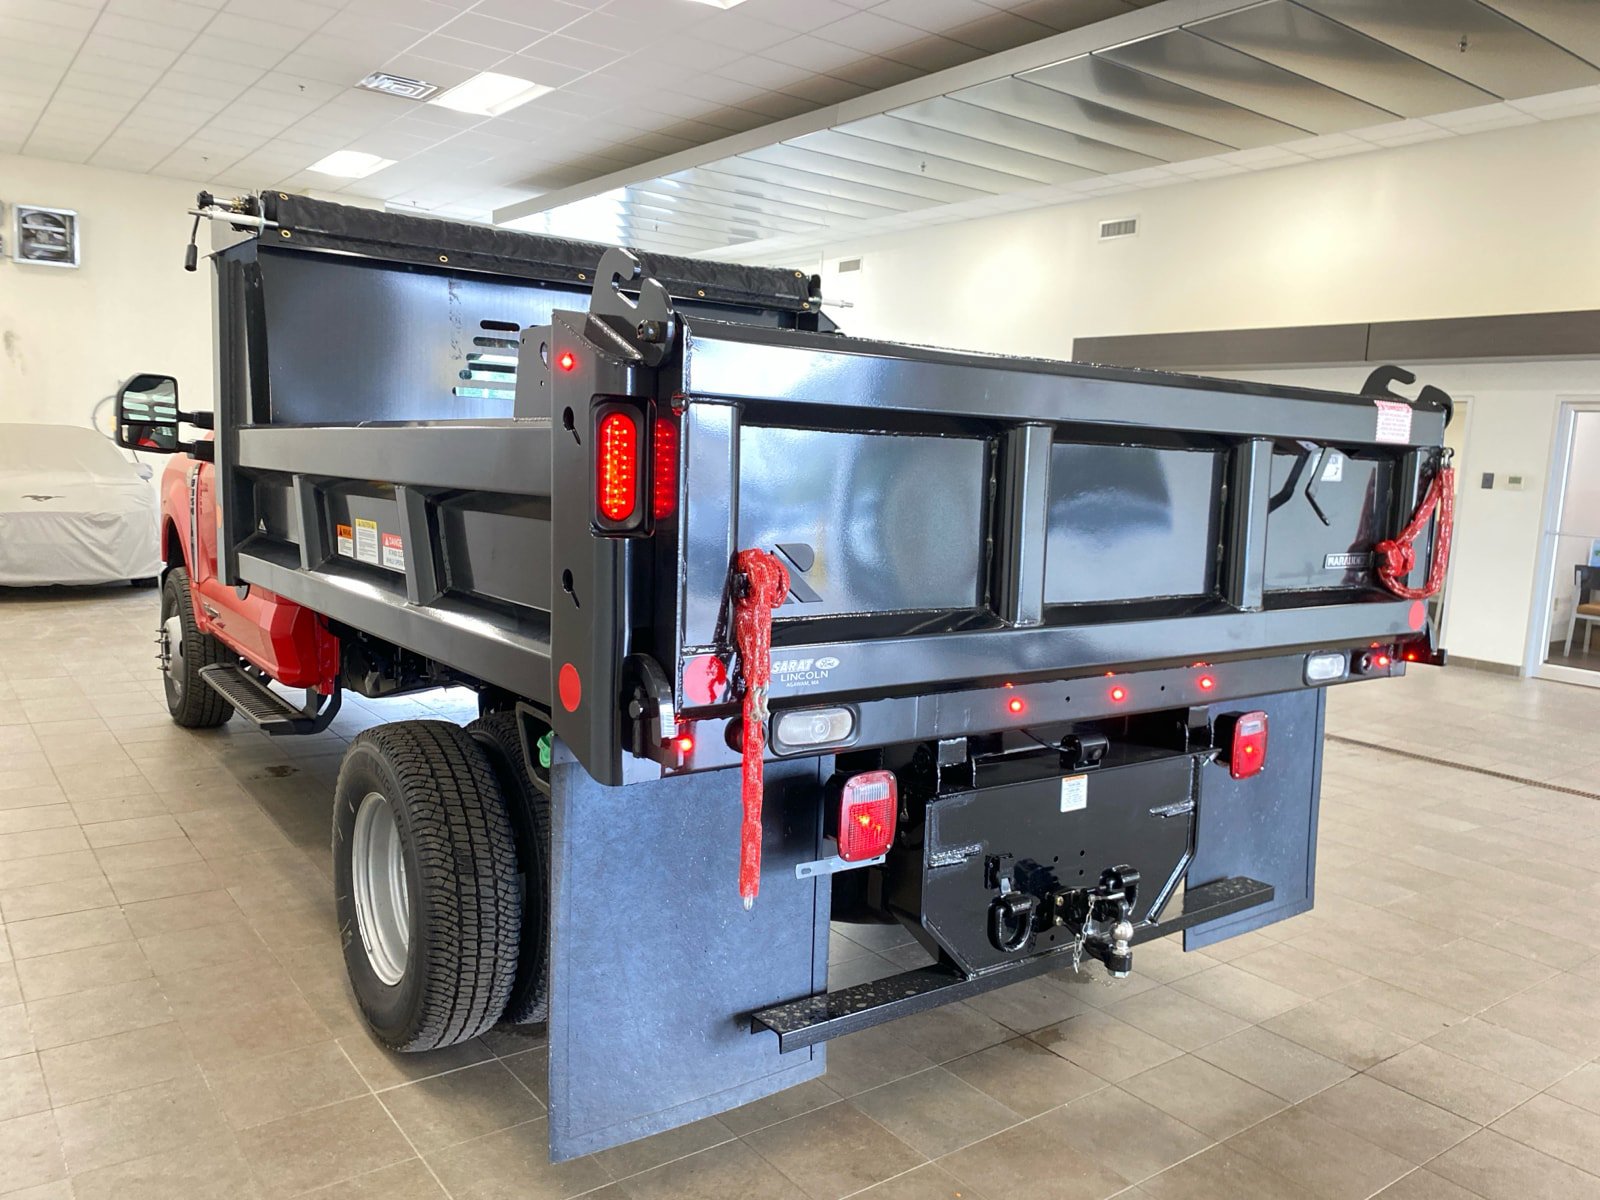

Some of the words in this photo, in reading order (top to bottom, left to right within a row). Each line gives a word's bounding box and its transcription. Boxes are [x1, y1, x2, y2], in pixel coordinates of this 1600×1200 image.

[1327, 556, 1366, 566] MARAUDE
[771, 659, 814, 674] SARAT
[781, 670, 828, 681] LINCOLN
